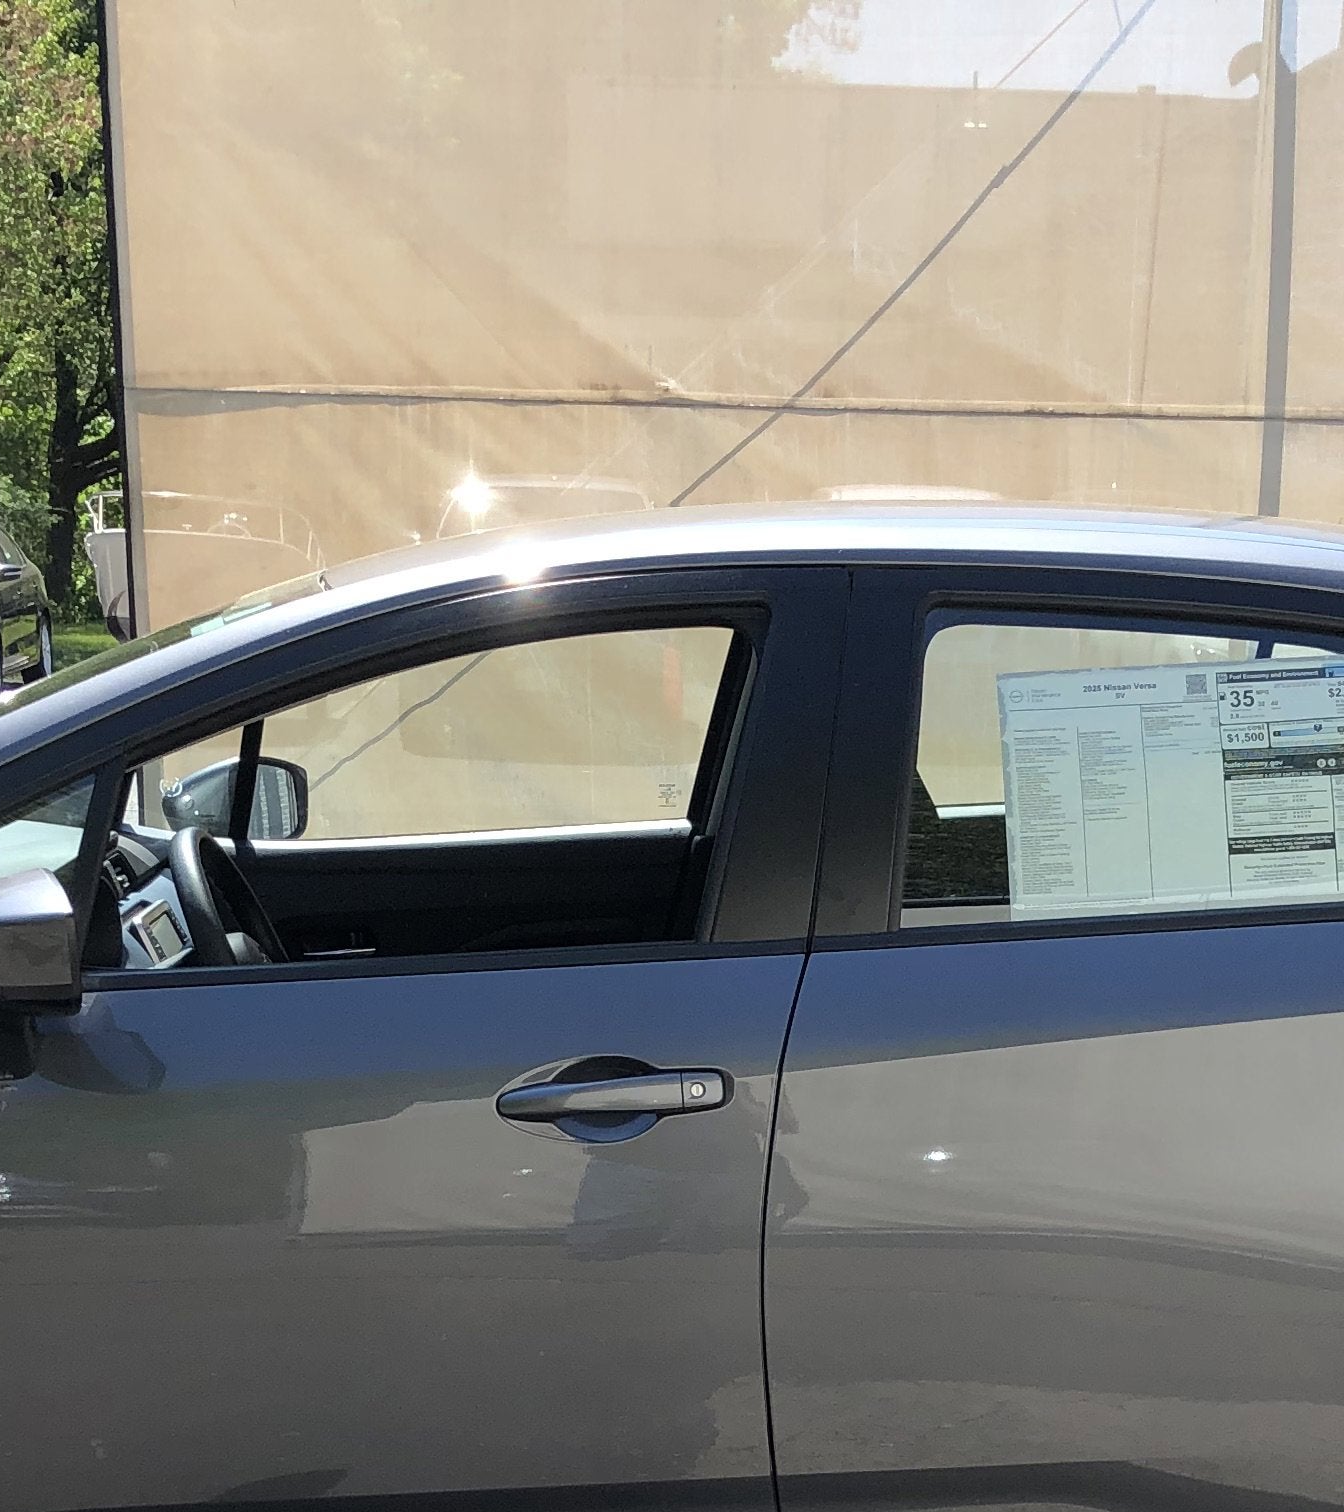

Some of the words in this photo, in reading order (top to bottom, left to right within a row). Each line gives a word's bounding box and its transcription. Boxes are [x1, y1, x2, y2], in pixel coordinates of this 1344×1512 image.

[1082, 684, 1102, 693] 2025
[1103, 683, 1132, 691] Nissan
[1133, 682, 1157, 690] Versa
[1229, 689, 1255, 708] 35
[1226, 732, 1265, 744] $1,500
